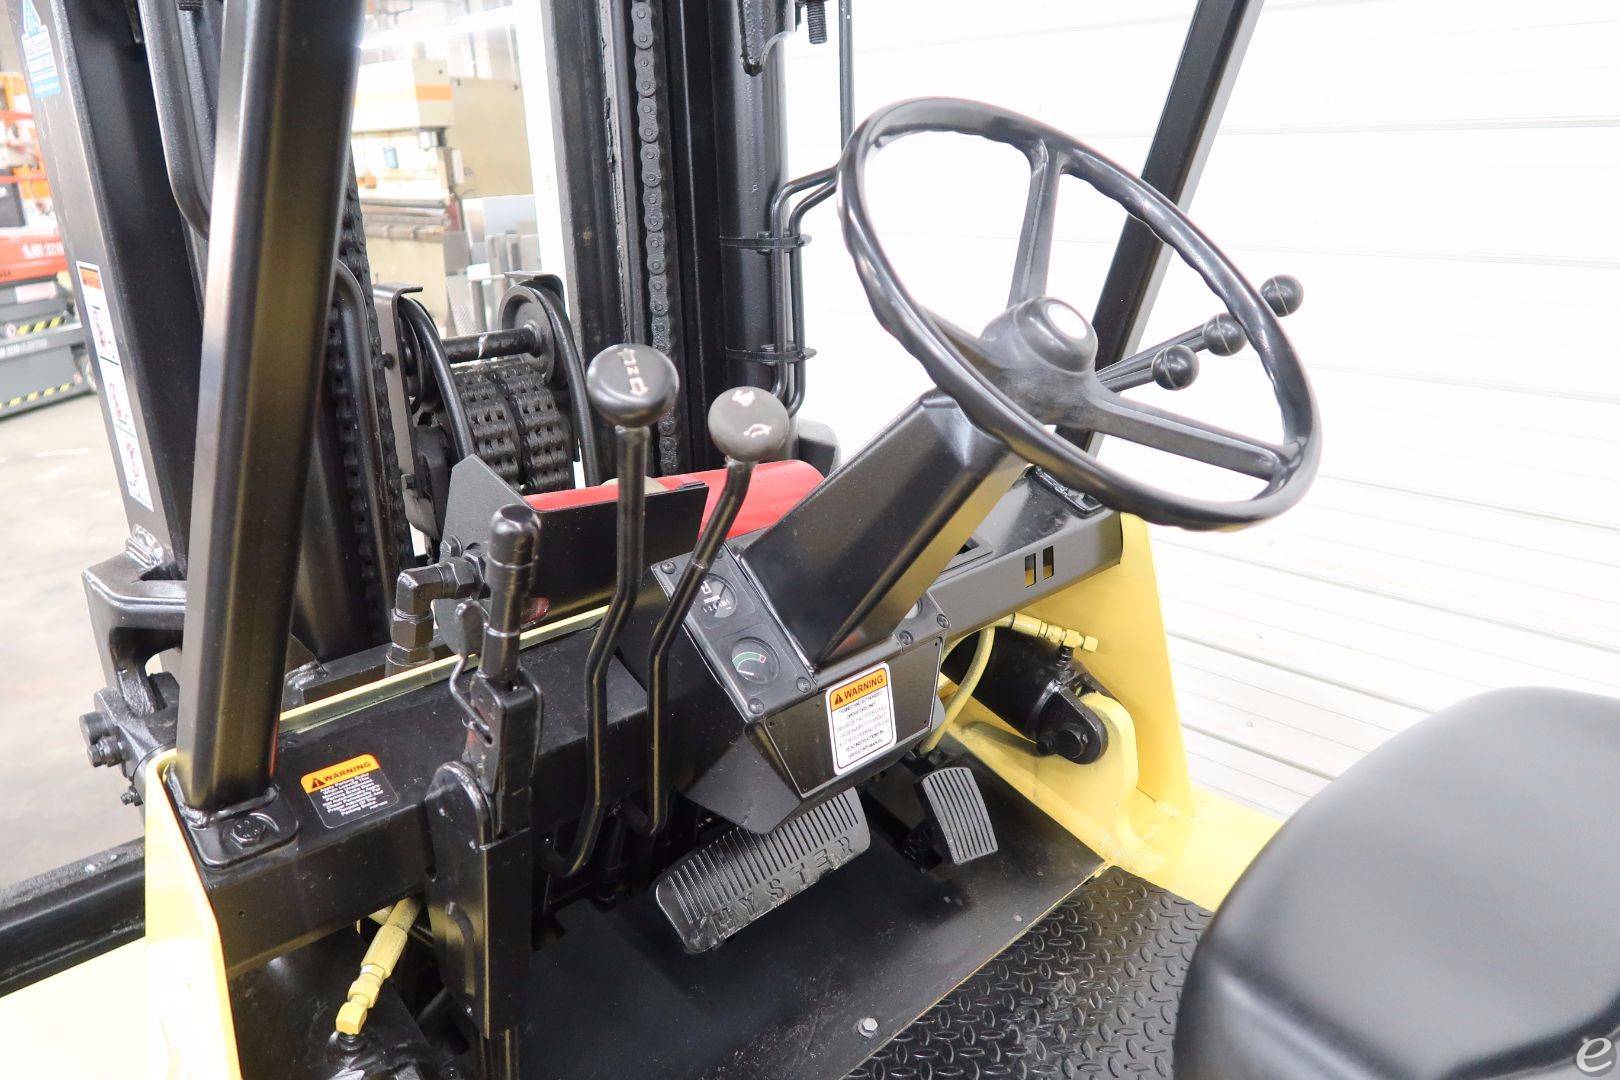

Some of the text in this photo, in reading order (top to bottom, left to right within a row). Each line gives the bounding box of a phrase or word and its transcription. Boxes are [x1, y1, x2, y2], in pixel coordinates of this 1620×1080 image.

[844, 674, 884, 700] WARNING
[323, 761, 371, 782] WARNING
[707, 836, 853, 935] HYSTER
